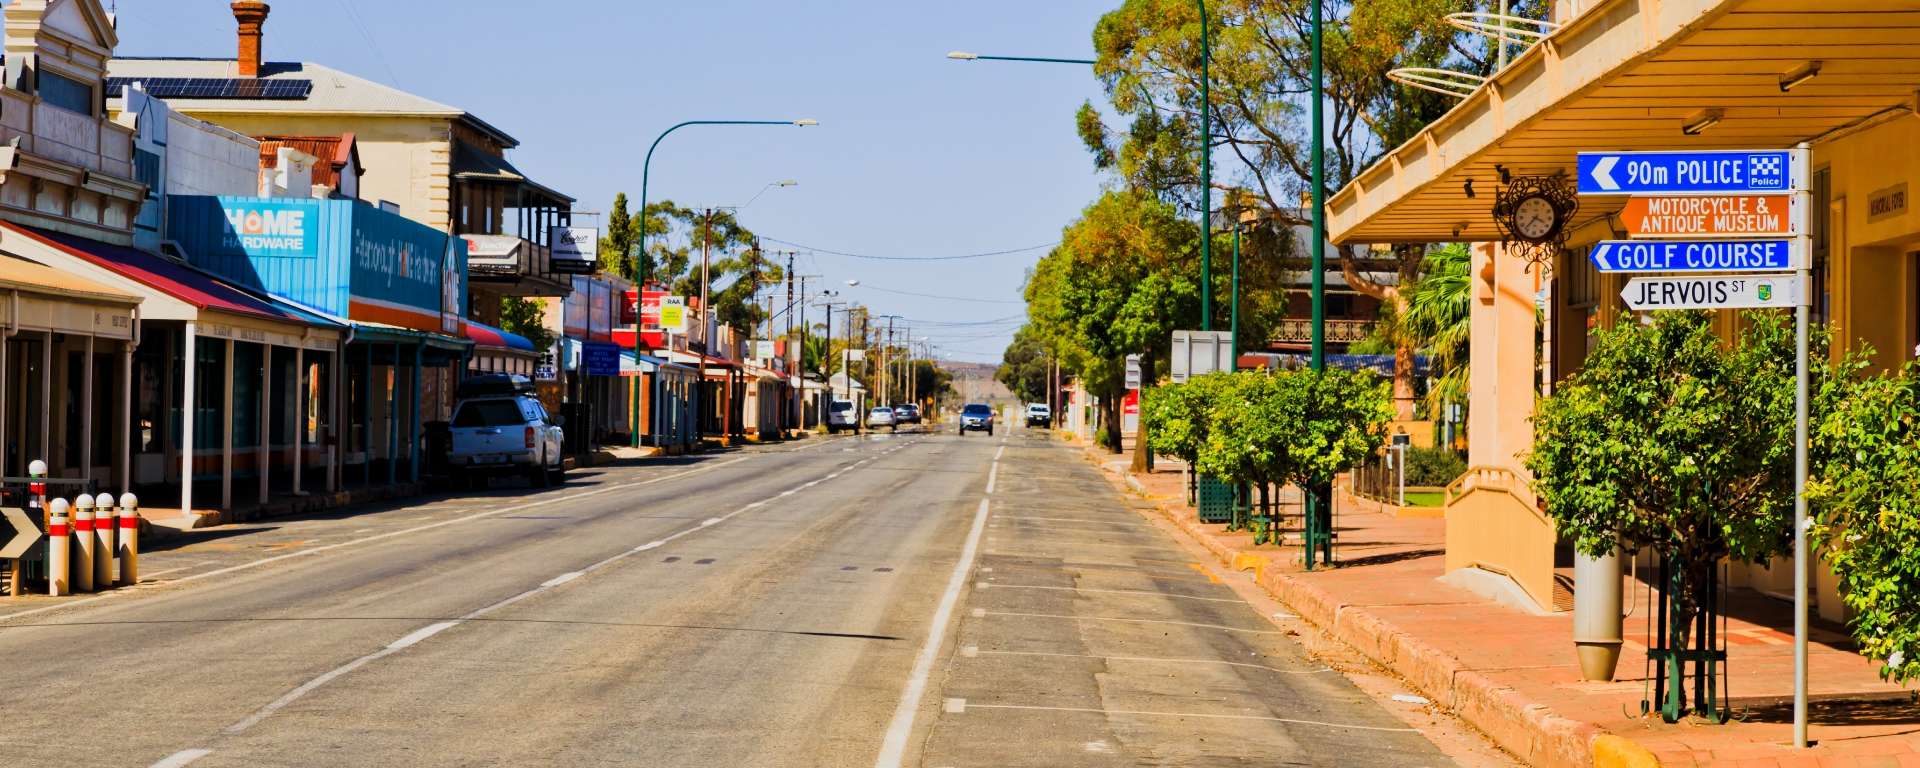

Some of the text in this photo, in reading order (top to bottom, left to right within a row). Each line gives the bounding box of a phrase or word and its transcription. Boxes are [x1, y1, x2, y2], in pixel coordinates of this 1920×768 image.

[1627, 159, 1743, 185] 90m POLICE
[1751, 177, 1780, 186] Police
[1648, 197, 1769, 215] MOTORCYCLE &
[223, 208, 304, 235] HOME
[1640, 214, 1779, 233] ANTIQUE MUSEUM
[222, 236, 304, 250] HARDWARE
[1617, 242, 1778, 269] GOLF COURSE
[1634, 280, 1746, 305] JERVOIS ST
